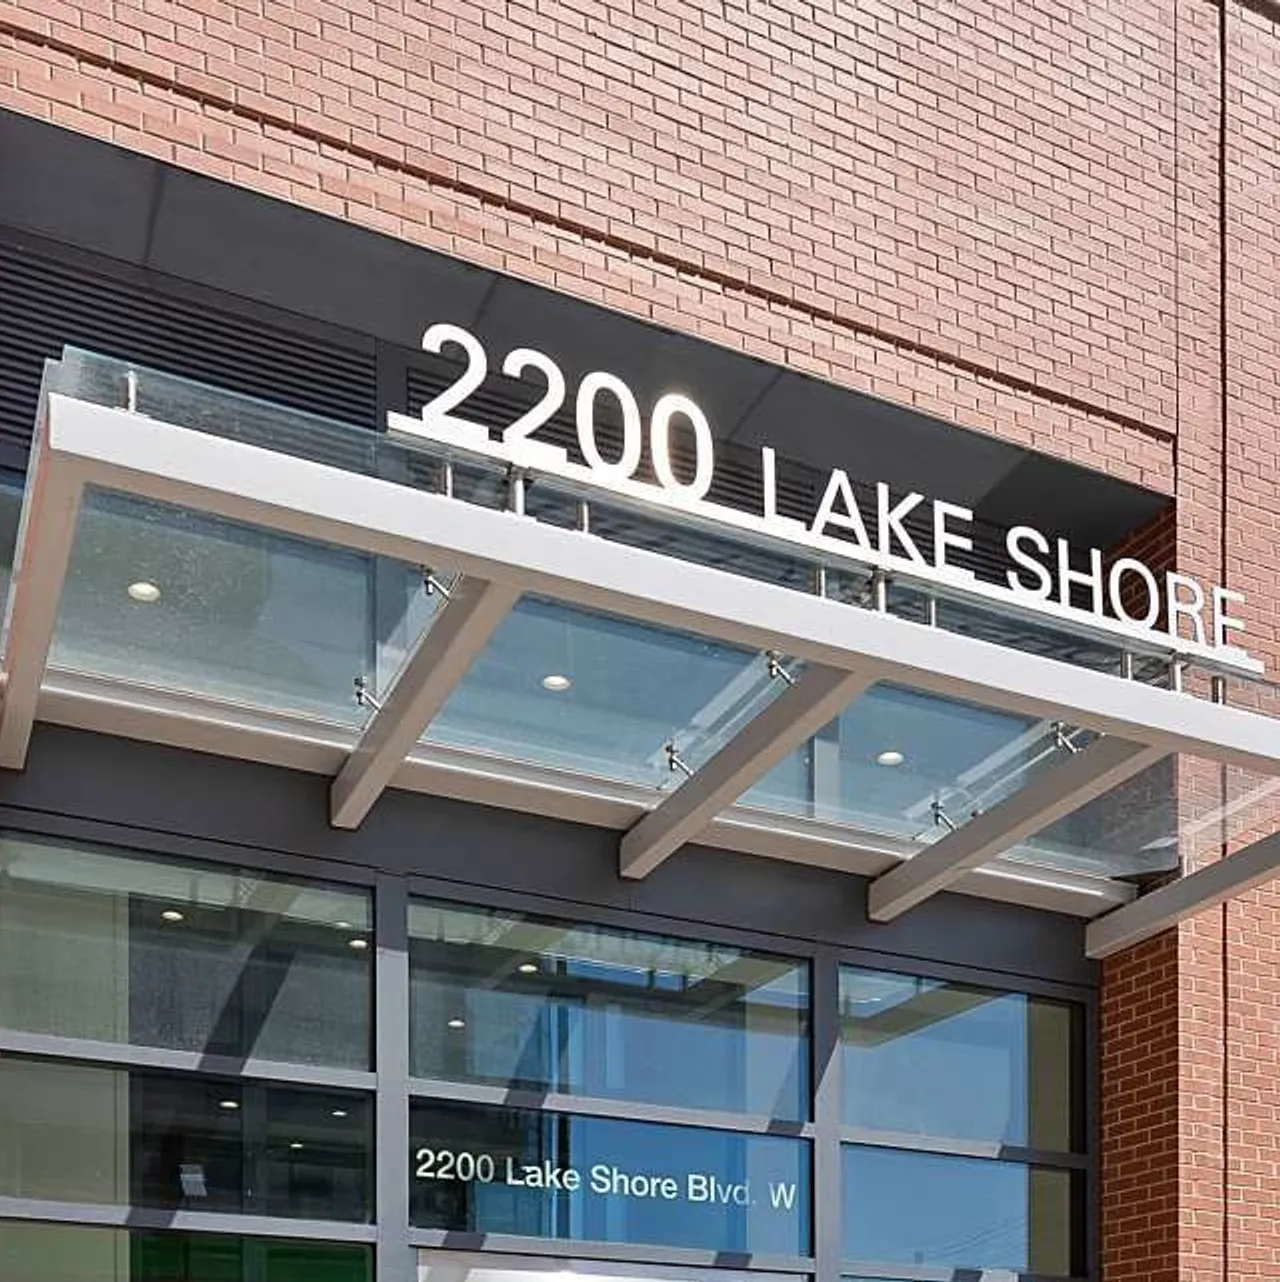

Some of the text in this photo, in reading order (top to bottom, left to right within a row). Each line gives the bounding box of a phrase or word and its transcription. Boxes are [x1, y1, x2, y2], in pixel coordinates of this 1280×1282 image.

[420, 322, 1250, 658] 2200 LAKE SHORE
[416, 1148, 797, 1210] 2200 Lake Shore Blvd. W
